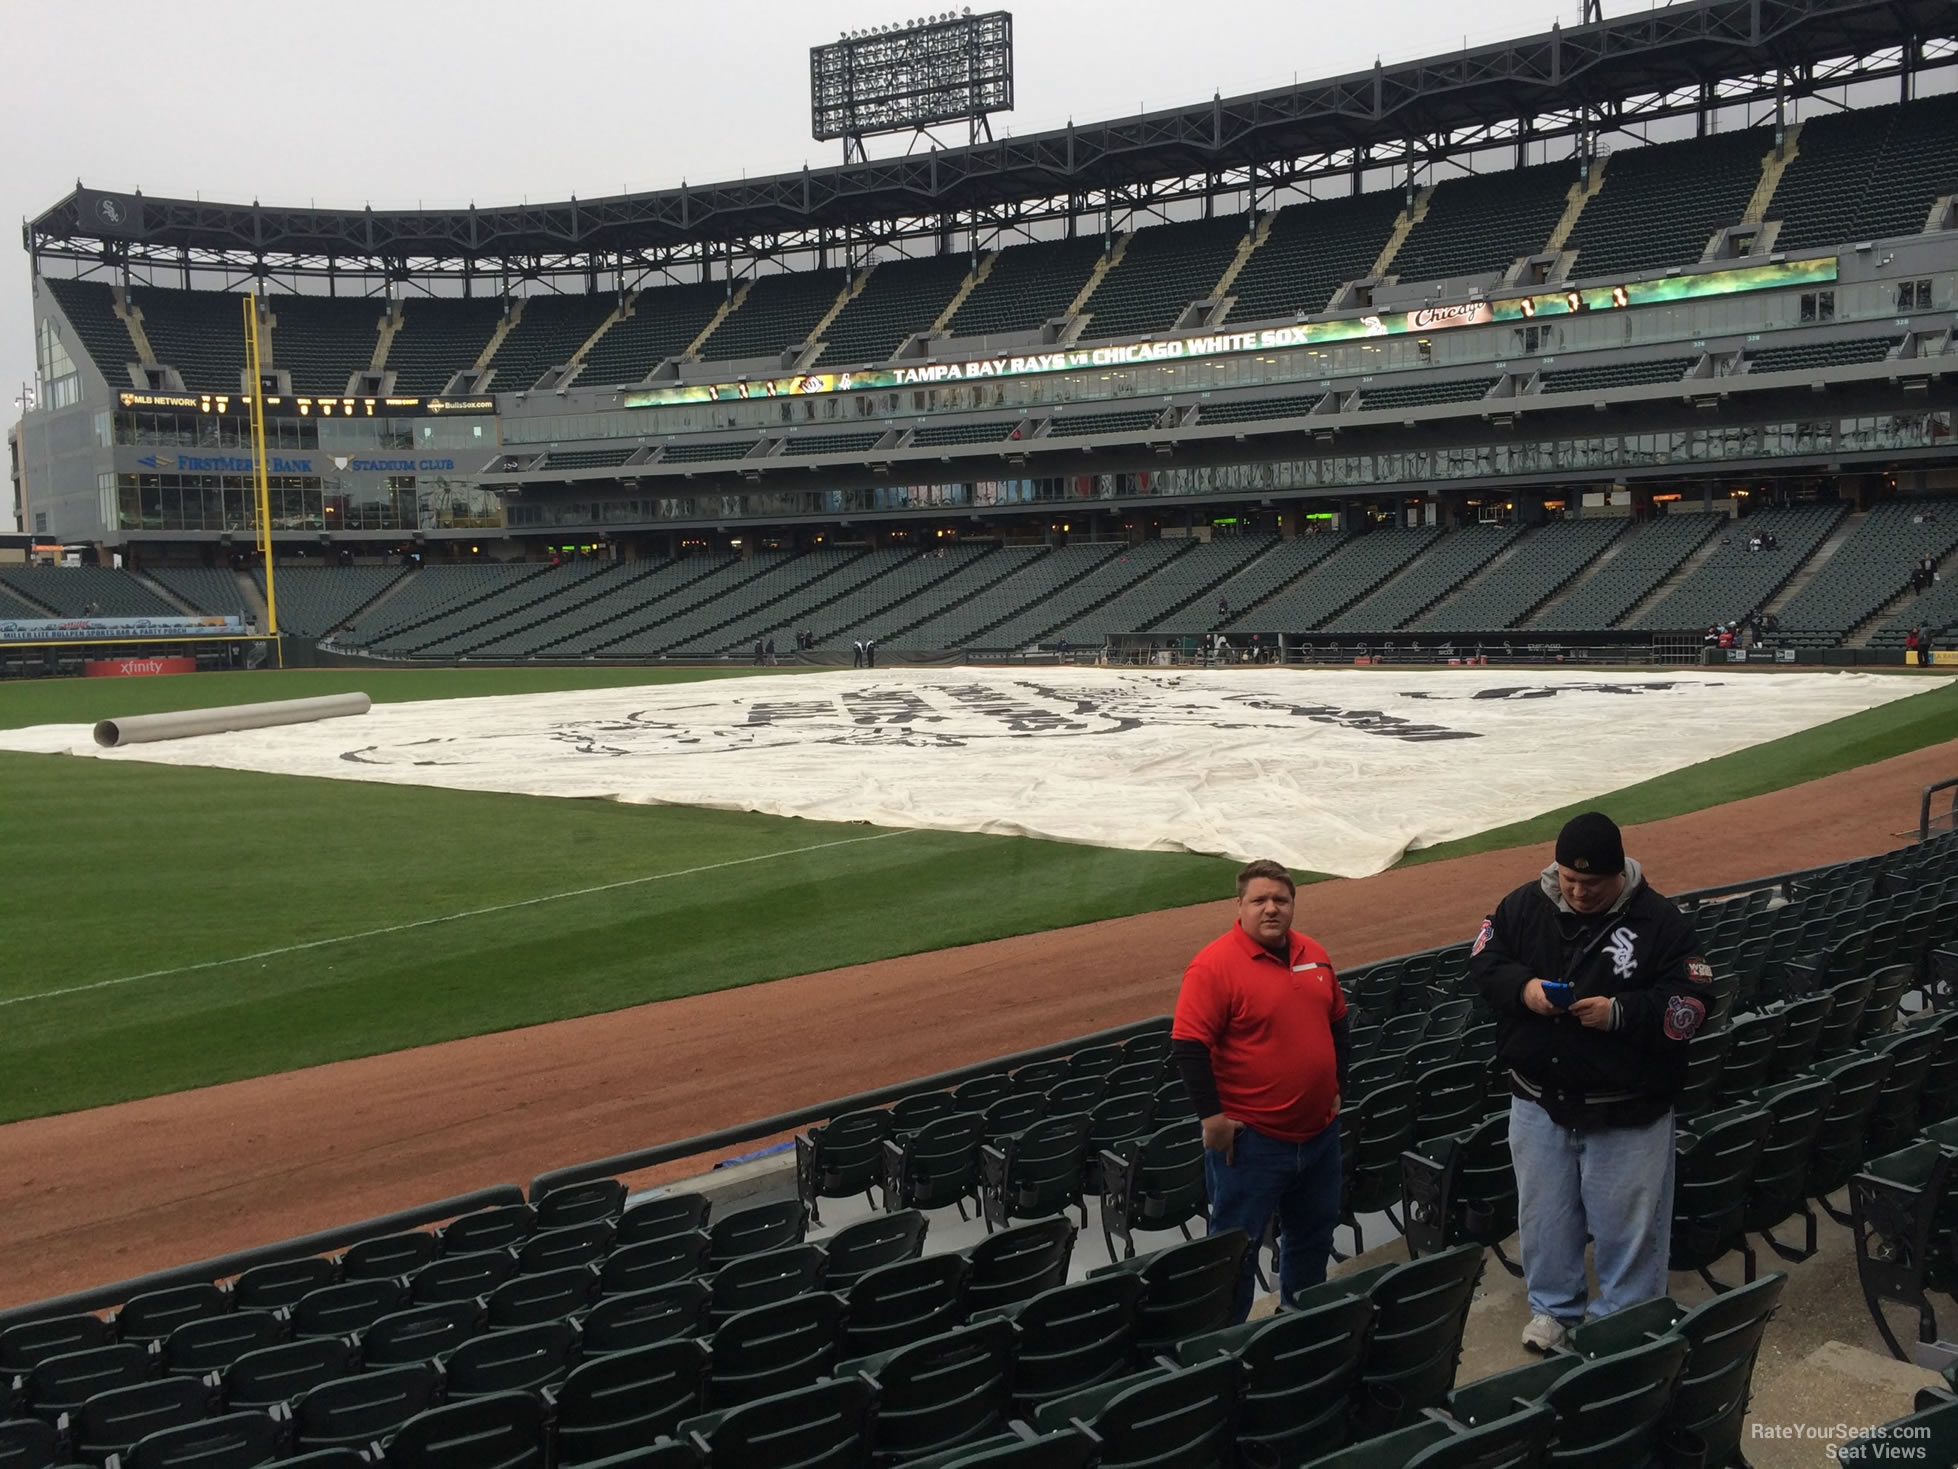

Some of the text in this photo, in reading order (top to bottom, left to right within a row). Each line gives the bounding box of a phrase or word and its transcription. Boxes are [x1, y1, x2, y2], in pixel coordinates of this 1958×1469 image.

[1415, 302, 1487, 327] Chicago
[893, 364, 962, 384] TAMPA
[966, 359, 1006, 378] BAY
[1011, 353, 1065, 373] RAYS
[1092, 341, 1182, 365] CHICAGO
[1186, 332, 1257, 354] WHITE
[1261, 326, 1308, 346] SOX
[134, 396, 152, 404] MLB
[154, 397, 197, 407] NETWORK
[352, 459, 454, 471] STADIUM CLUB
[120, 660, 163, 675] xfinity
